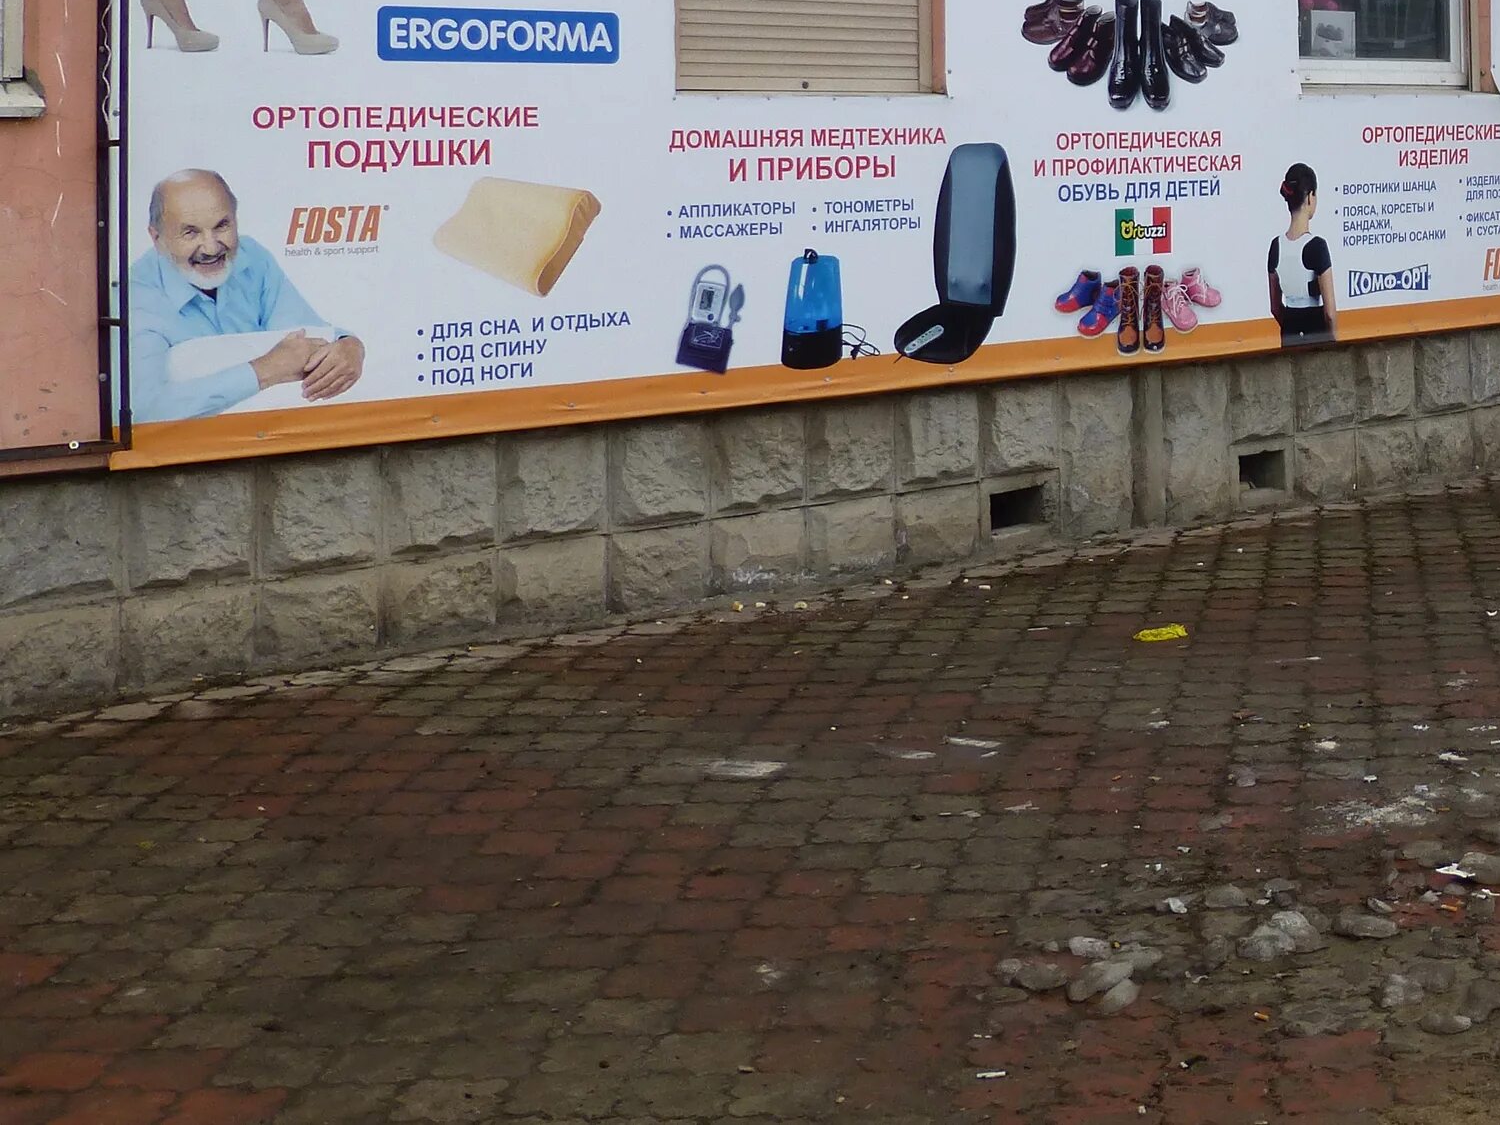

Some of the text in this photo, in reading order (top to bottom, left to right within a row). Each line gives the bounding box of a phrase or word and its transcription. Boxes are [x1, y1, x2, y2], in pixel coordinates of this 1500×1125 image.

[389, 16, 613, 54] ERGOFORMA
[252, 106, 540, 132] ОРТОПЕДИЧЕСКИЕ
[669, 127, 947, 152] ДОМАШНЯЯ МЕДТЕХНИКА
[1056, 130, 1222, 152] ОРТОПЕДИЧЕСКАЯ
[307, 139, 493, 173] ПОДУШКИ
[1034, 154, 1242, 177] И ПРОФИЛАКТИЧЕСКАЯ
[1399, 148, 1469, 170] ИЗДЕЛИЯ
[729, 155, 897, 182] И ПРИБОРЫ
[1058, 175, 1221, 203] ОБУВЬ ДЛЯ ДЕТЕЙ
[1342, 179, 1437, 195] ВОРОТНИКИ ШАНЦА
[1466, 188, 1484, 203] ДЛЯ
[678, 201, 796, 219] АППЛИКАТОРЫ
[824, 198, 914, 215] ТОНОМЕТРЫ
[1342, 201, 1435, 219] ПОЯСА, КОРСЕТЫ И
[286, 205, 382, 245] FOSTA
[680, 221, 783, 240] МАССАЖЕРЫ
[824, 216, 922, 234] ИНГАЛЯТОРЫ
[1120, 220, 1168, 241] Ortuzzi
[1342, 217, 1393, 233] БАНДАЖИ,
[1466, 225, 1473, 237] И
[1342, 228, 1447, 248] КОРРЕКТОРЫ ОСАНКИ
[285, 248, 312, 257] health
[323, 247, 344, 257] sport
[347, 245, 379, 256] support
[1350, 264, 1429, 297] КОМФ-ОРТ
[430, 311, 631, 342] ДЛЯ СНА И ОТДЫХА
[431, 339, 548, 365] ПОД СПИНУ
[431, 362, 533, 387] ПОД НОГИ
